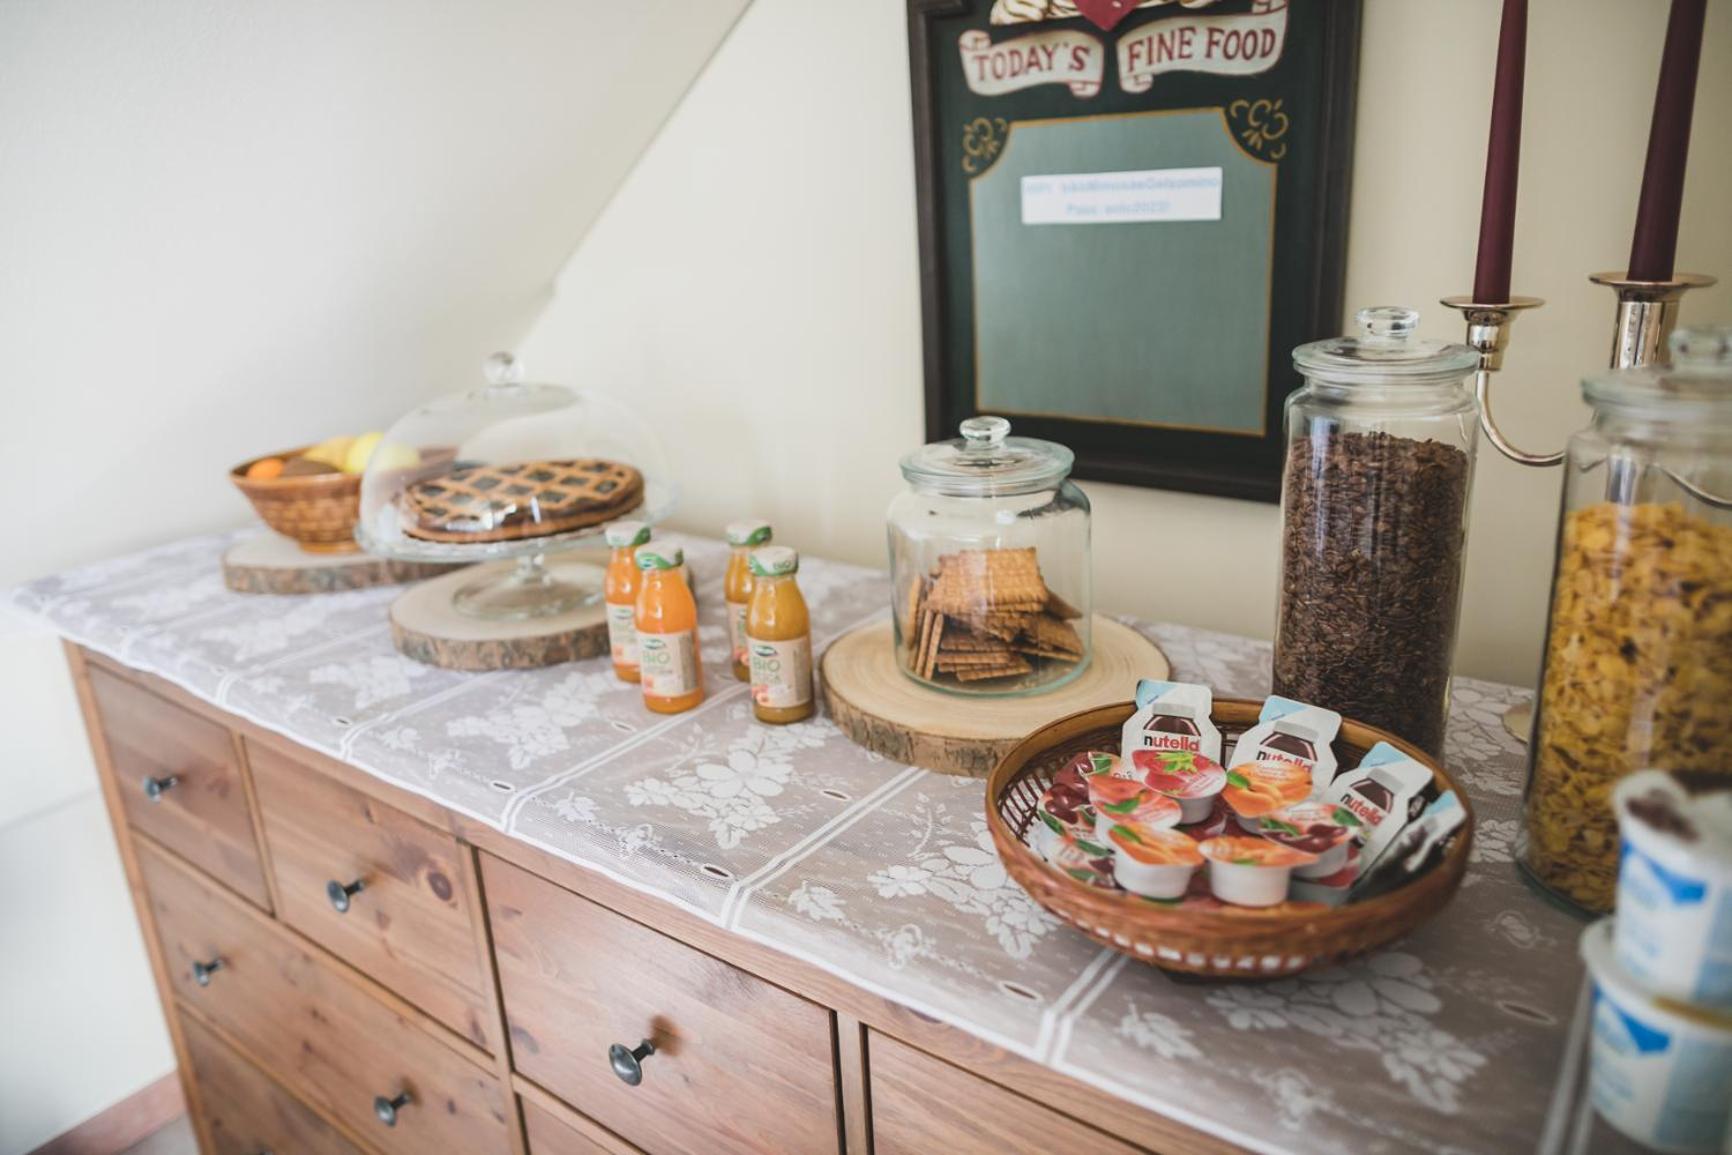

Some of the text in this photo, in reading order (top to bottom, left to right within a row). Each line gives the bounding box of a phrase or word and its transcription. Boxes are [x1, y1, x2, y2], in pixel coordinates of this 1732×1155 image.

[972, 42, 1092, 81] TODAY'S
[1127, 26, 1276, 73] FINE FOOD
[1143, 735, 1200, 751] nutella
[1340, 793, 1384, 826] nutella
